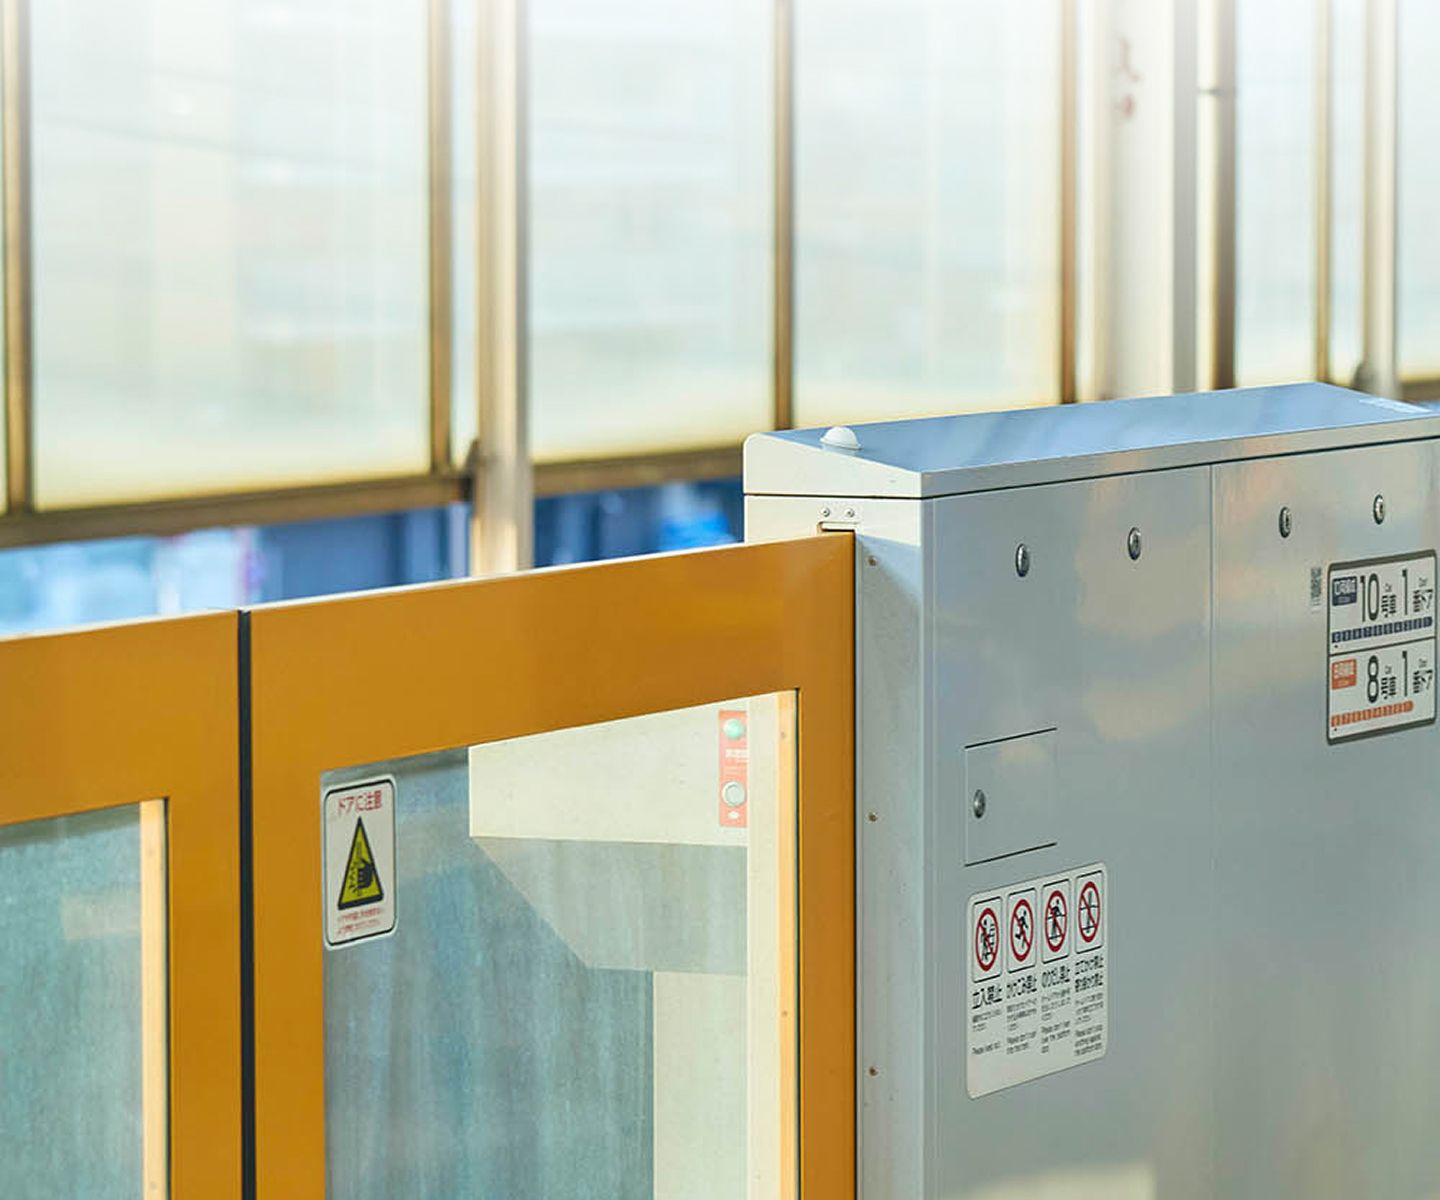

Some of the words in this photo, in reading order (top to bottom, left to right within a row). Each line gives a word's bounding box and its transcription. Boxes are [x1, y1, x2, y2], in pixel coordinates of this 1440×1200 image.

[1360, 572, 1379, 622] 10
[1381, 594, 1397, 618] 号車
[1402, 568, 1408, 616] 1
[1413, 588, 1433, 613] 番ドア
[1367, 654, 1379, 703] 8
[1381, 676, 1397, 700] 号車
[1402, 650, 1408, 697] 1
[1413, 668, 1433, 694] 番ドア
[338, 789, 382, 816] ドアに注意
[972, 985, 1003, 1009] 立入禁止
